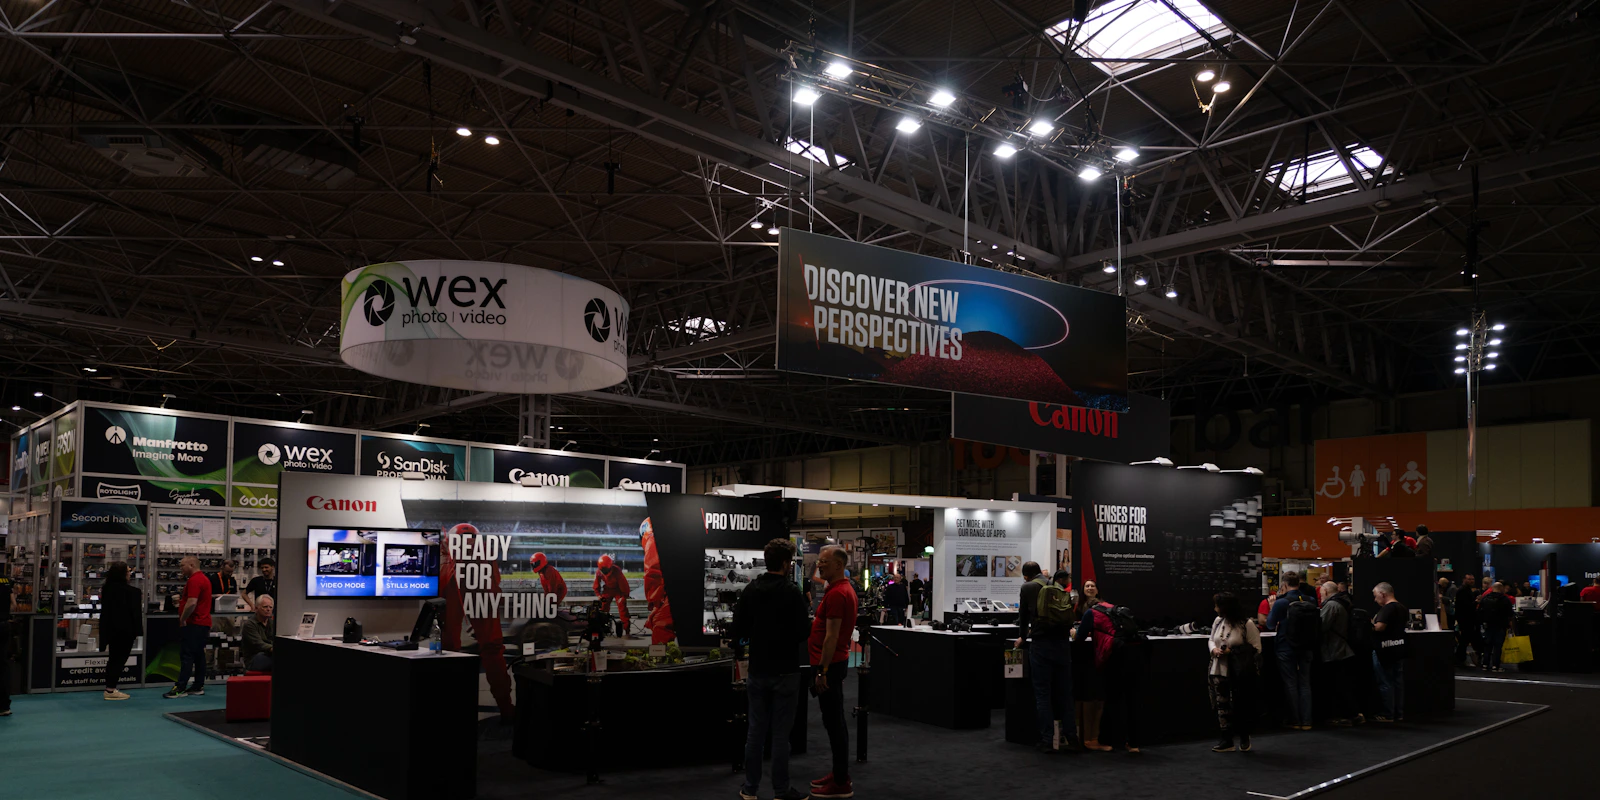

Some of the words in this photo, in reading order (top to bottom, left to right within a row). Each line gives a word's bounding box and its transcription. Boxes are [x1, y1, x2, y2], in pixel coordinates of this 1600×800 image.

[403, 276, 507, 310] wex
[804, 264, 909, 316] DISCOVER
[915, 285, 959, 324] NEW
[403, 309, 447, 327] photo
[460, 310, 507, 325] video
[814, 305, 963, 361] PERSPECTIVES
[1029, 401, 1118, 438] Canon
[57, 429, 76, 457] EPSON
[132, 436, 208, 452] Manfrotto
[132, 449, 175, 461] Imagine
[177, 453, 204, 463] More
[284, 445, 334, 463] wex
[284, 461, 307, 469] photo
[394, 456, 448, 474] SanDisk
[99, 489, 139, 497] ROTOLIGHT
[175, 498, 211, 506] NINJA
[239, 494, 278, 507] Godo
[306, 495, 377, 512] Canon
[72, 513, 109, 523] Second
[112, 515, 137, 524] hand
[705, 512, 727, 530] PRO
[729, 513, 760, 531] VIDEO
[1094, 504, 1128, 523] LENSES
[1129, 506, 1146, 524] FOR
[956, 519, 966, 528] GET
[966, 519, 981, 528] MORE
[982, 520, 994, 529] WITH
[958, 528, 969, 537] OUR
[970, 529, 986, 537] RANGE
[986, 529, 993, 538] OF
[993, 530, 1006, 538] APPS
[1097, 524, 1105, 541] A
[1106, 524, 1127, 542] NEW
[1128, 525, 1146, 543] ERA
[449, 534, 511, 561] READY
[456, 563, 493, 590] FOR
[463, 593, 558, 619] ANYTHING
[1381, 639, 1404, 649] Nikon
[69, 667, 93, 675] credit
